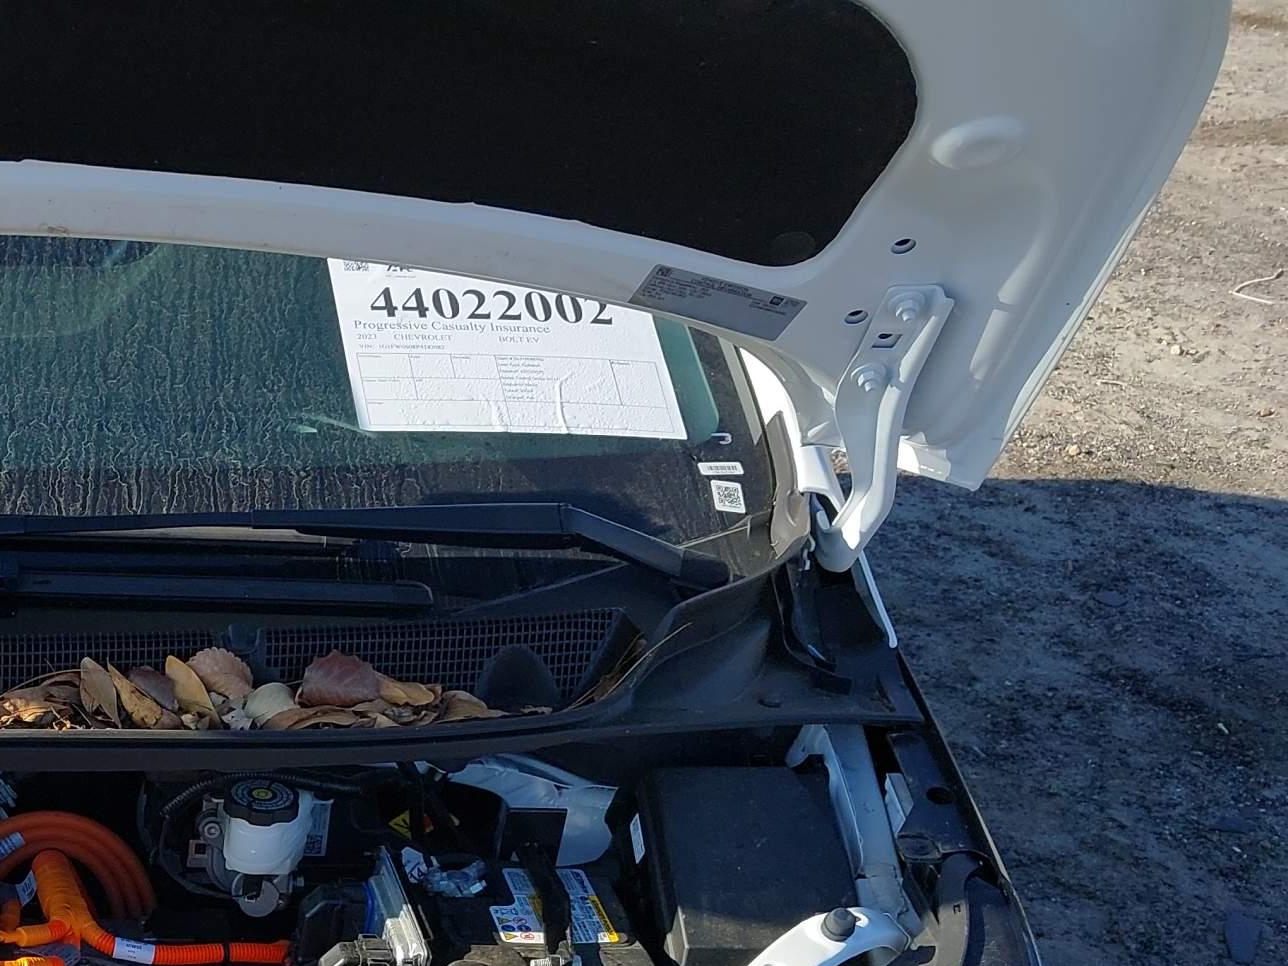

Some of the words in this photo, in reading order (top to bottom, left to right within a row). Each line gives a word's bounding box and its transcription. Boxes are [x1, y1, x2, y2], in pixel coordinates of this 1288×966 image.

[370, 287, 613, 325] 44022002
[354, 319, 428, 332] Progressive
[431, 321, 486, 334] Casualty
[490, 322, 551, 334] Insurance
[393, 333, 452, 341] CHEVROLET
